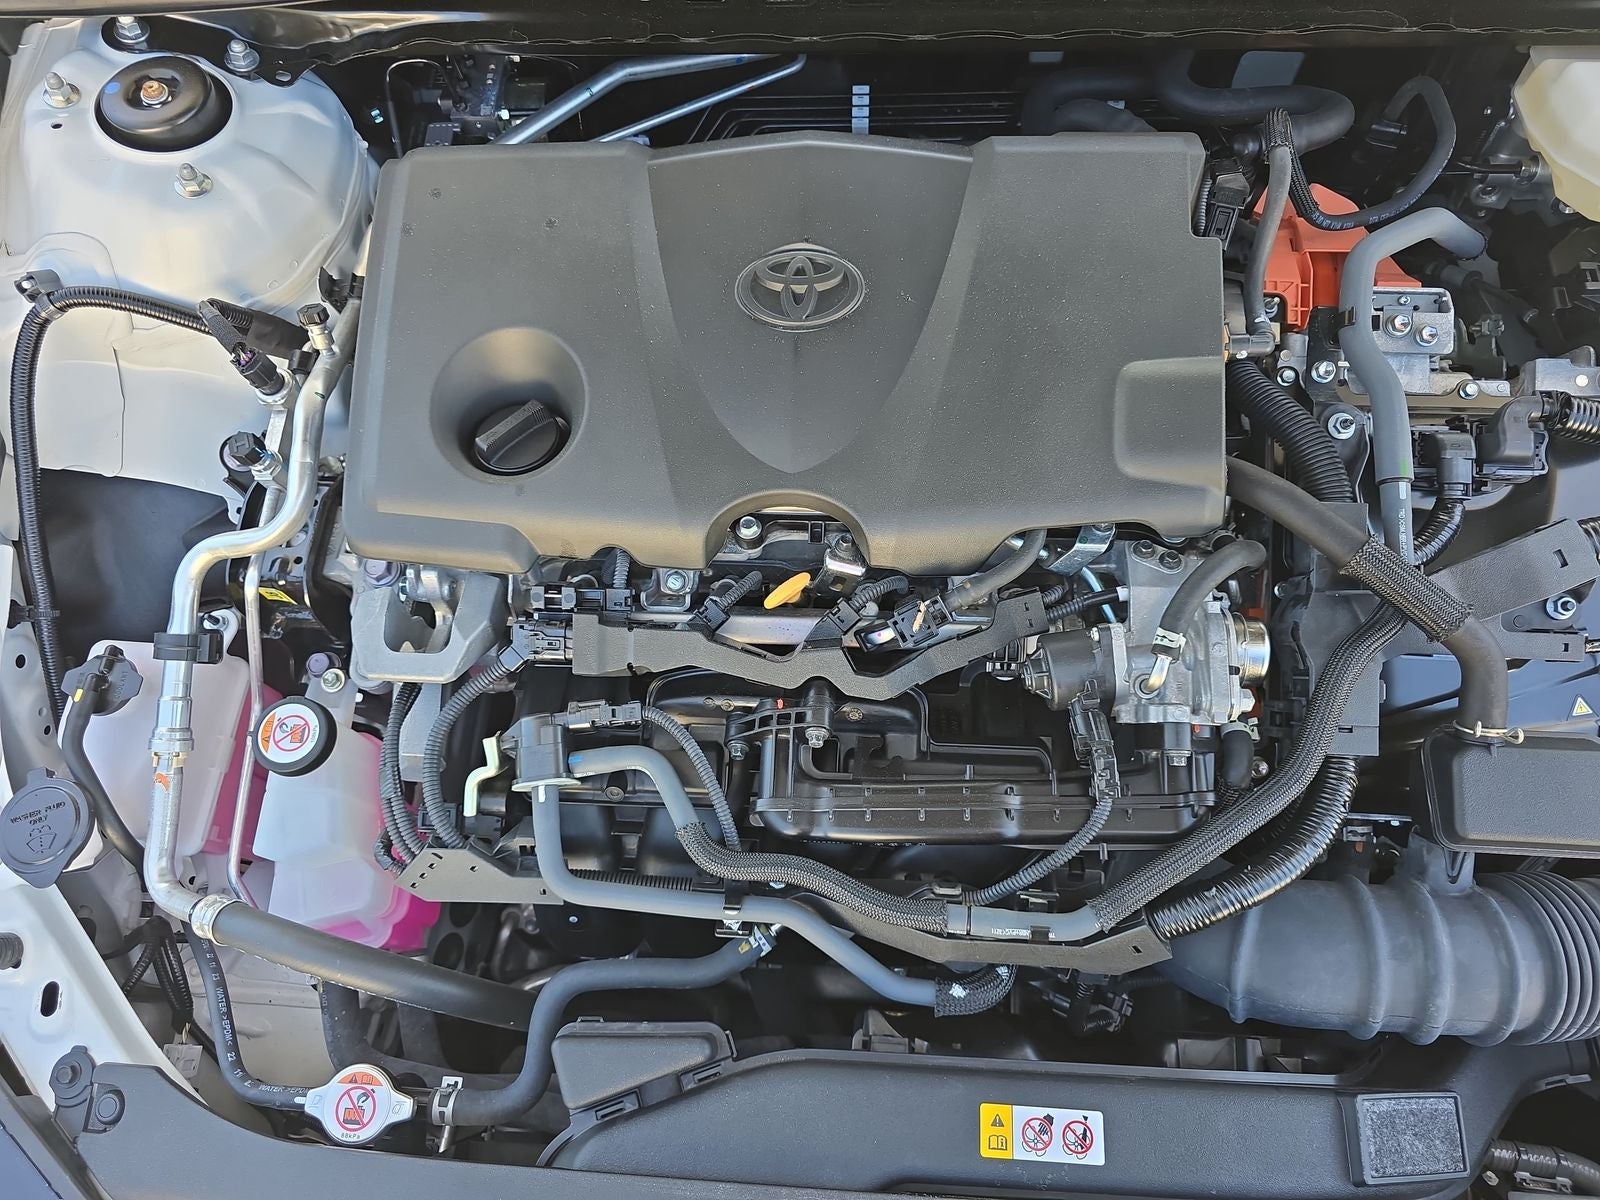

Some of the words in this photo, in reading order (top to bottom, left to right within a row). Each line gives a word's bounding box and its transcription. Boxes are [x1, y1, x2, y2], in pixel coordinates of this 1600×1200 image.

[215, 986, 228, 1014] WATER
[227, 1051, 237, 1062] 22
[258, 1084, 284, 1093] WATER
